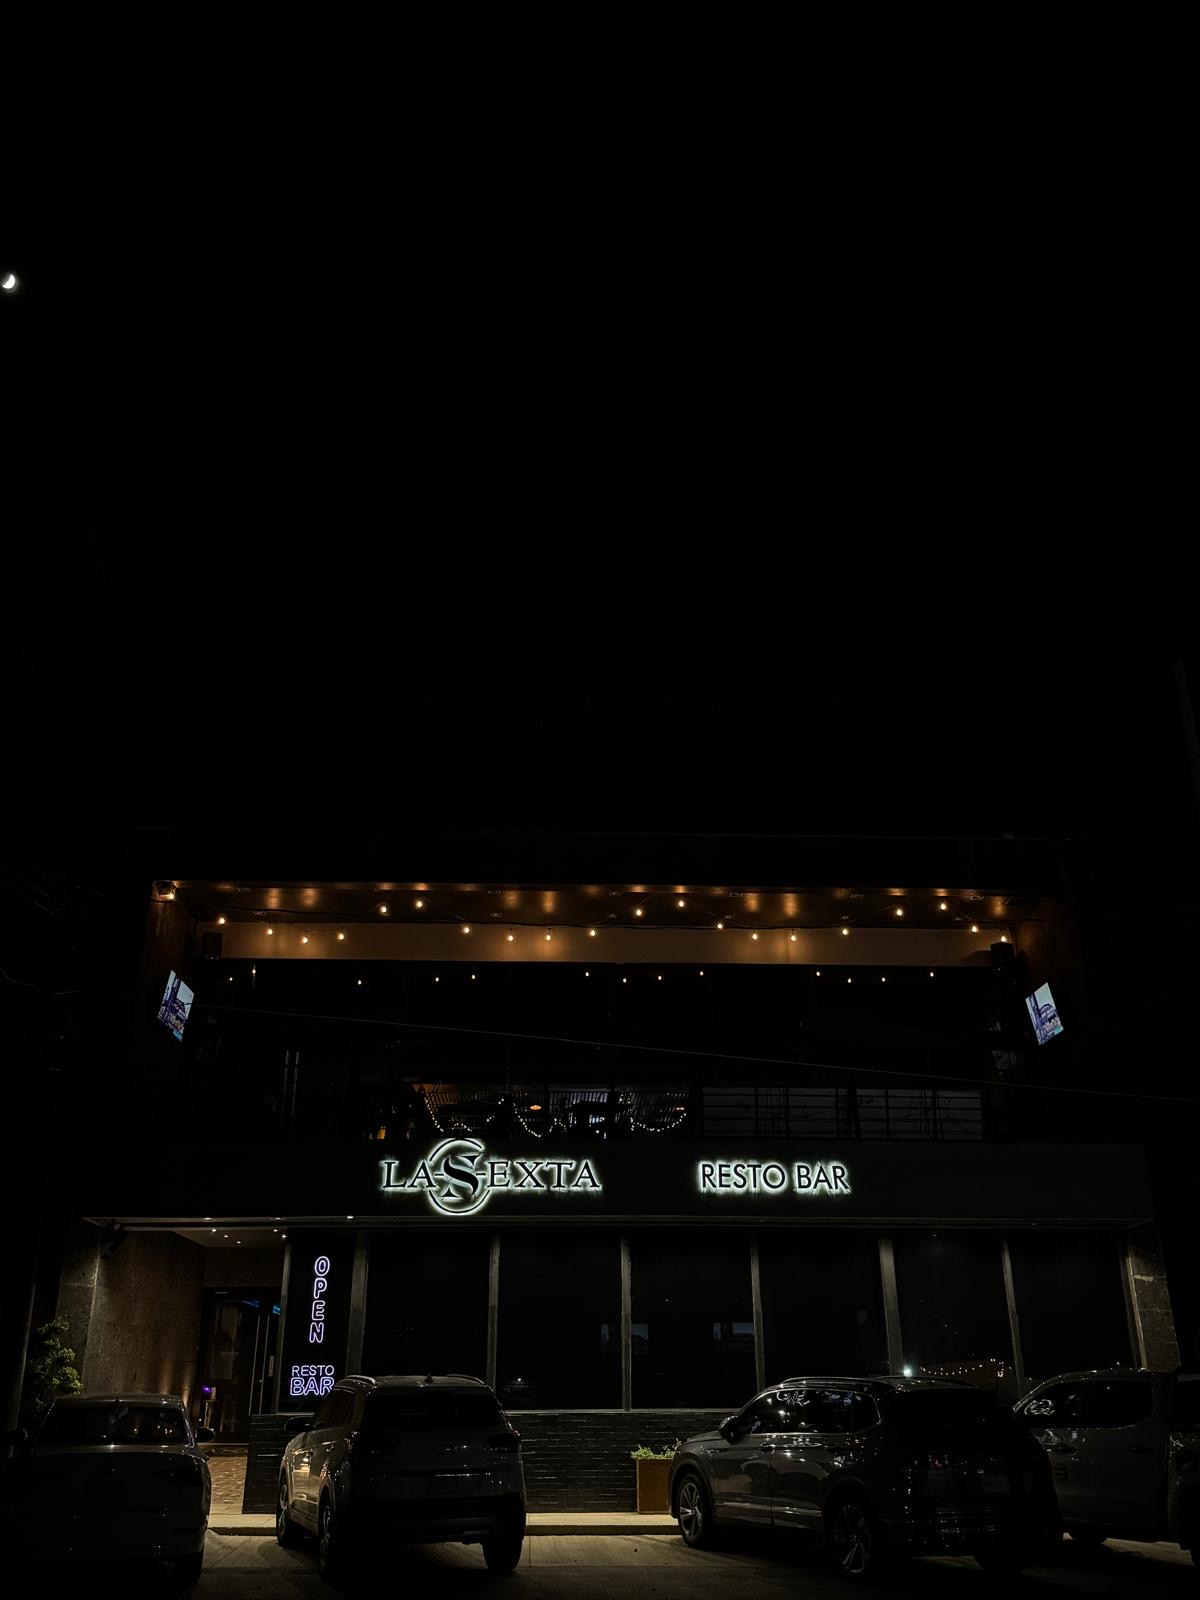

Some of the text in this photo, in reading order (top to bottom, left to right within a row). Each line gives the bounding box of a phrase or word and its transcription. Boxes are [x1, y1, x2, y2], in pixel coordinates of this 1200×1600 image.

[381, 1153, 601, 1202] LA SEXTA
[700, 1161, 851, 1191] RESTO BAR
[309, 1255, 330, 1343] OPEN
[291, 1364, 335, 1377] RESTO
[289, 1376, 335, 1396] BAR
